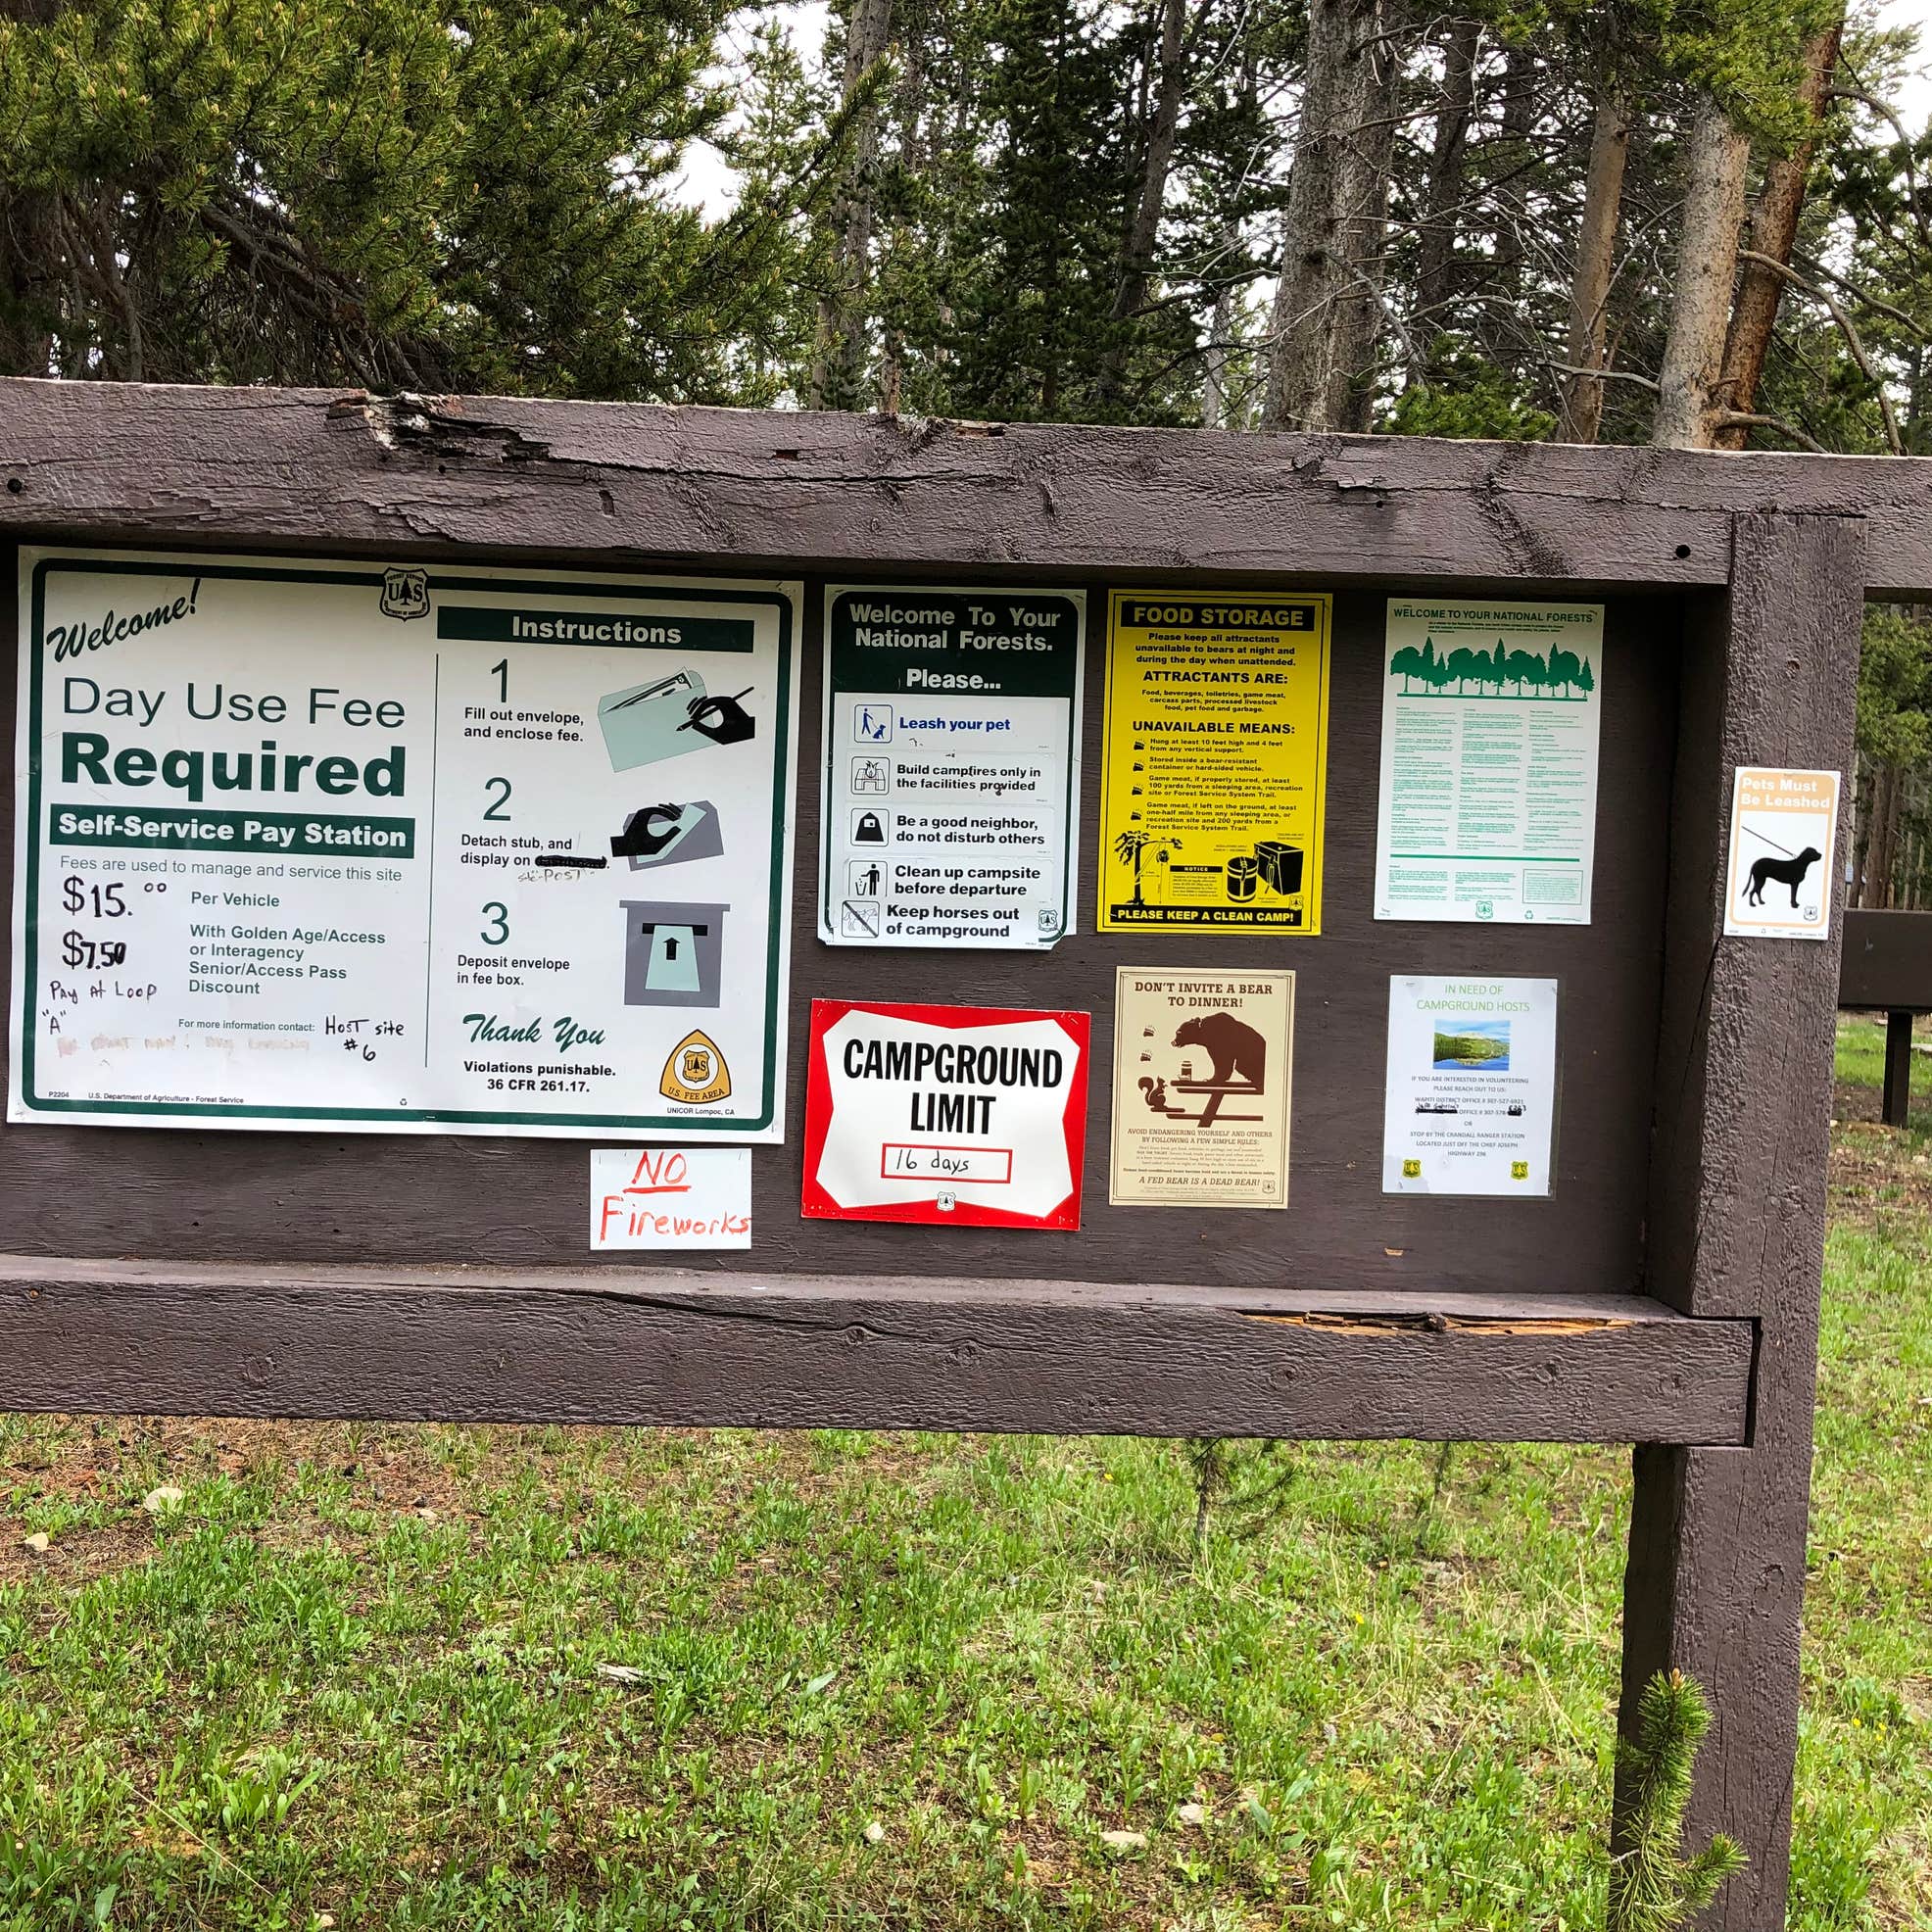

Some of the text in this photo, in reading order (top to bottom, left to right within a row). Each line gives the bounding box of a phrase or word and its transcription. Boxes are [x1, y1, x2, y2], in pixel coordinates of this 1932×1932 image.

[46, 578, 201, 663] Welcome!
[849, 604, 1061, 627] Welcome To Your
[1134, 607, 1303, 626] FOOD STORAGE
[1393, 608, 1593, 623] WELCOME TO YOUR NATIONAL FORESTS
[512, 616, 681, 644] Instructions
[855, 628, 1052, 651] National Forests.
[491, 658, 507, 702] 1
[906, 668, 1001, 689] Please...
[1143, 670, 1287, 684] ATTRACTANTS ARE:
[64, 677, 405, 728] Day Use Fee
[465, 707, 584, 726] Fill out envelope,
[899, 717, 1010, 733] Leash your pet
[1133, 721, 1295, 734] UNAVAILABLE MEANS:
[464, 726, 583, 742] and enclose fee.
[62, 732, 406, 800] Required
[897, 764, 1040, 779] Build campfires only in
[896, 778, 1036, 792] the facilities provided
[1742, 777, 1816, 792] Pets Must
[483, 777, 511, 821] 2
[1740, 794, 1830, 808] Be Leashed
[59, 813, 407, 847] Self-Service Pay Station
[897, 815, 1038, 831] Be a good neighbor,
[461, 834, 572, 850] Detach stub, and
[896, 831, 1044, 845] do not disturb others
[460, 852, 509, 868] display
[513, 856, 530, 866] on
[61, 855, 402, 882] Fees are used to manage and service this site
[895, 865, 1040, 881] Clean up campsite
[894, 882, 1027, 897] before departure
[191, 892, 279, 907] Per Vehicle
[887, 904, 1019, 920] Keep horses out
[1118, 909, 1293, 922] PLEASE KEEP A CLEAN CAMP!
[481, 901, 509, 945] 3
[886, 922, 1009, 939] of campground
[190, 924, 386, 944] With Golden Age/Access
[62, 929, 127, 970] $7.50
[189, 943, 304, 962] or Interagency
[189, 961, 347, 979] Senior/Access Pass
[458, 954, 570, 972] Deposit envelope
[189, 980, 260, 994] Discount
[458, 972, 524, 986] in fee box.
[1135, 982, 1273, 994] DON'T INVITE A BEAR
[1445, 985, 1504, 995] IN NEED OF
[1168, 996, 1242, 1007] TO DINNER!
[1417, 999, 1530, 1012] CAMPGROUND HOSTS
[178, 1019, 194, 1028] For
[222, 1020, 275, 1031] information
[278, 1023, 315, 1032] contact:
[462, 1014, 605, 1053] Thank You
[463, 1061, 615, 1077] Violations punishable.
[844, 1038, 1062, 1087] CAMPGROUND
[487, 1079, 590, 1092] 36 CFR 261.17.
[668, 1087, 681, 1097] U.S.
[702, 1088, 725, 1100] AREA
[910, 1092, 996, 1135] LIMIT
[896, 1149, 970, 1175] 16 days
[600, 1195, 751, 1244] Fireworks
